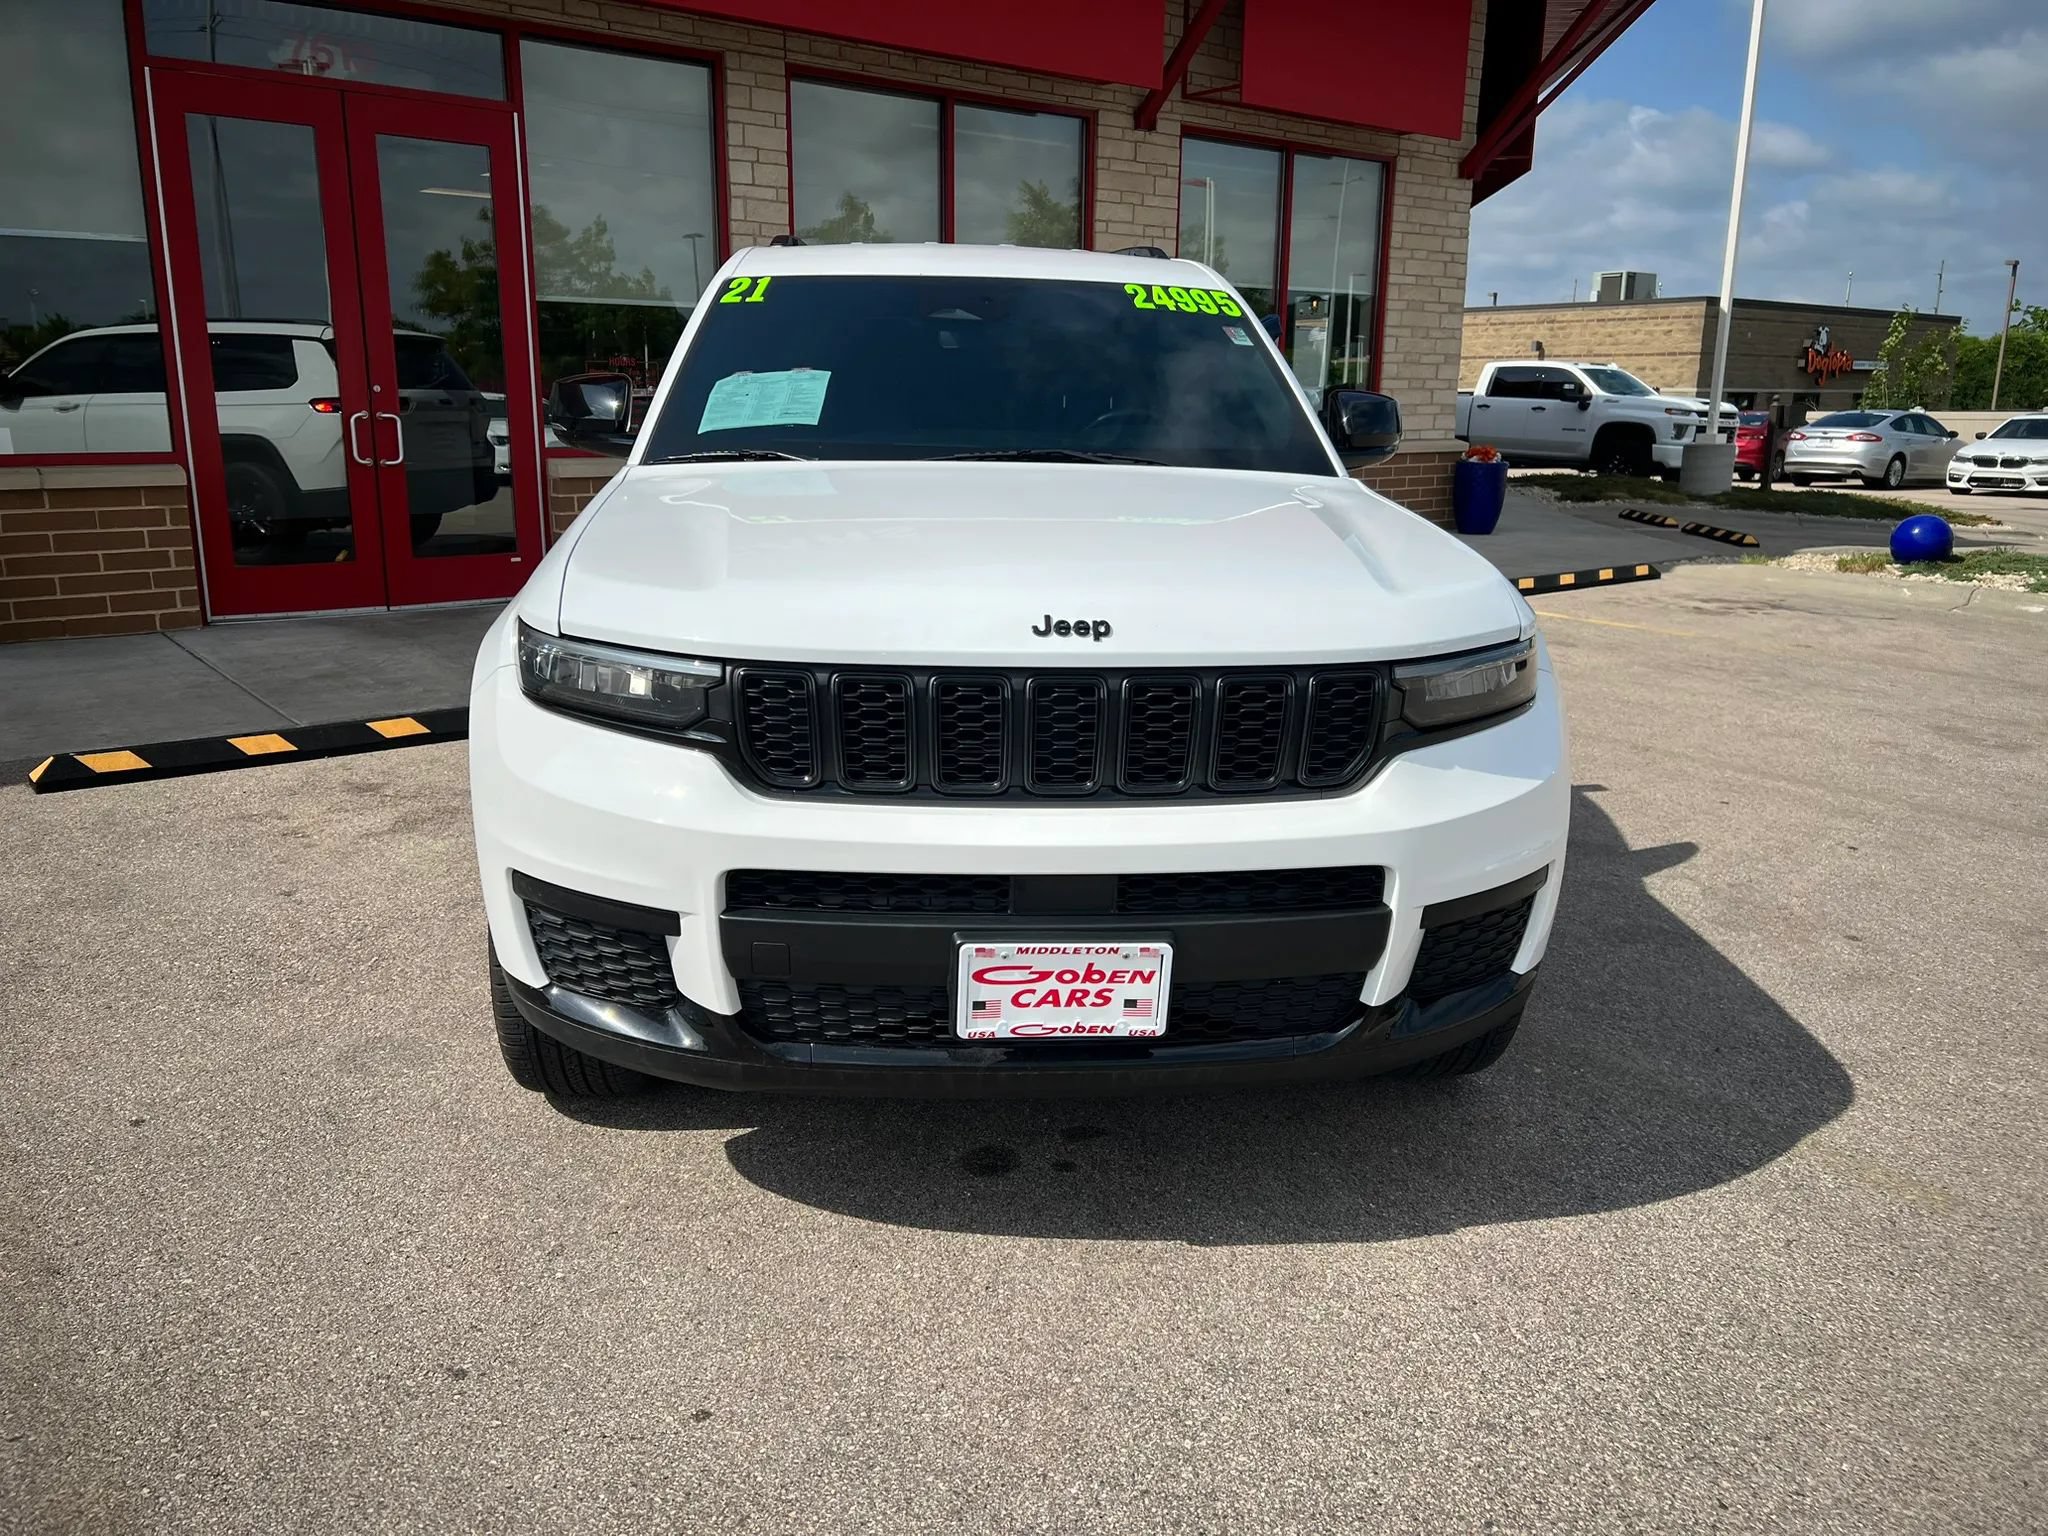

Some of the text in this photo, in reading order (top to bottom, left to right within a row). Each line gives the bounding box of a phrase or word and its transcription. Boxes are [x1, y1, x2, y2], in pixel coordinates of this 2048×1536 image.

[719, 276, 772, 304] 21
[1123, 283, 1243, 318] 24995
[1031, 614, 1113, 642] Jeep
[1015, 946, 1121, 955] MIDDLETON
[1010, 988, 1116, 1009] CARS
[967, 1031, 997, 1039] USA
[1128, 1028, 1158, 1037] USA
